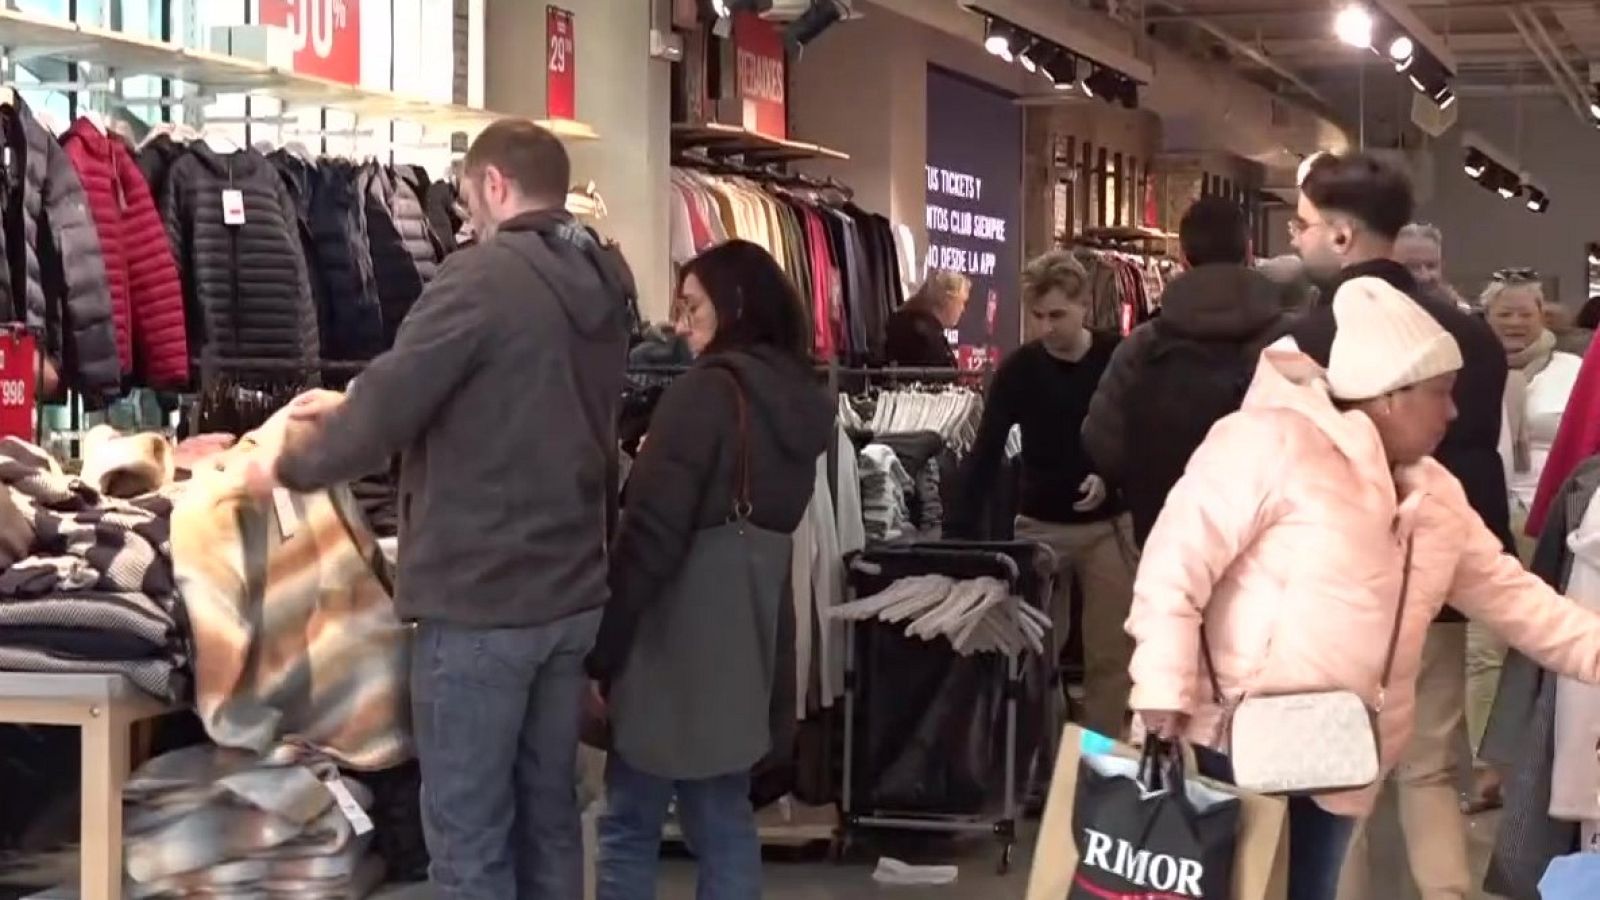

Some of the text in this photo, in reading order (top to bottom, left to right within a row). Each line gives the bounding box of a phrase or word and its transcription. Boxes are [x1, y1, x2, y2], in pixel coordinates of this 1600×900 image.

[925, 164, 982, 201] US TICKETS Y
[950, 210, 972, 236] CLUB
[973, 214, 1006, 242] SIEMPRE
[941, 246, 967, 272] DESDE
[968, 250, 979, 272] LA
[981, 252, 996, 275] APP
